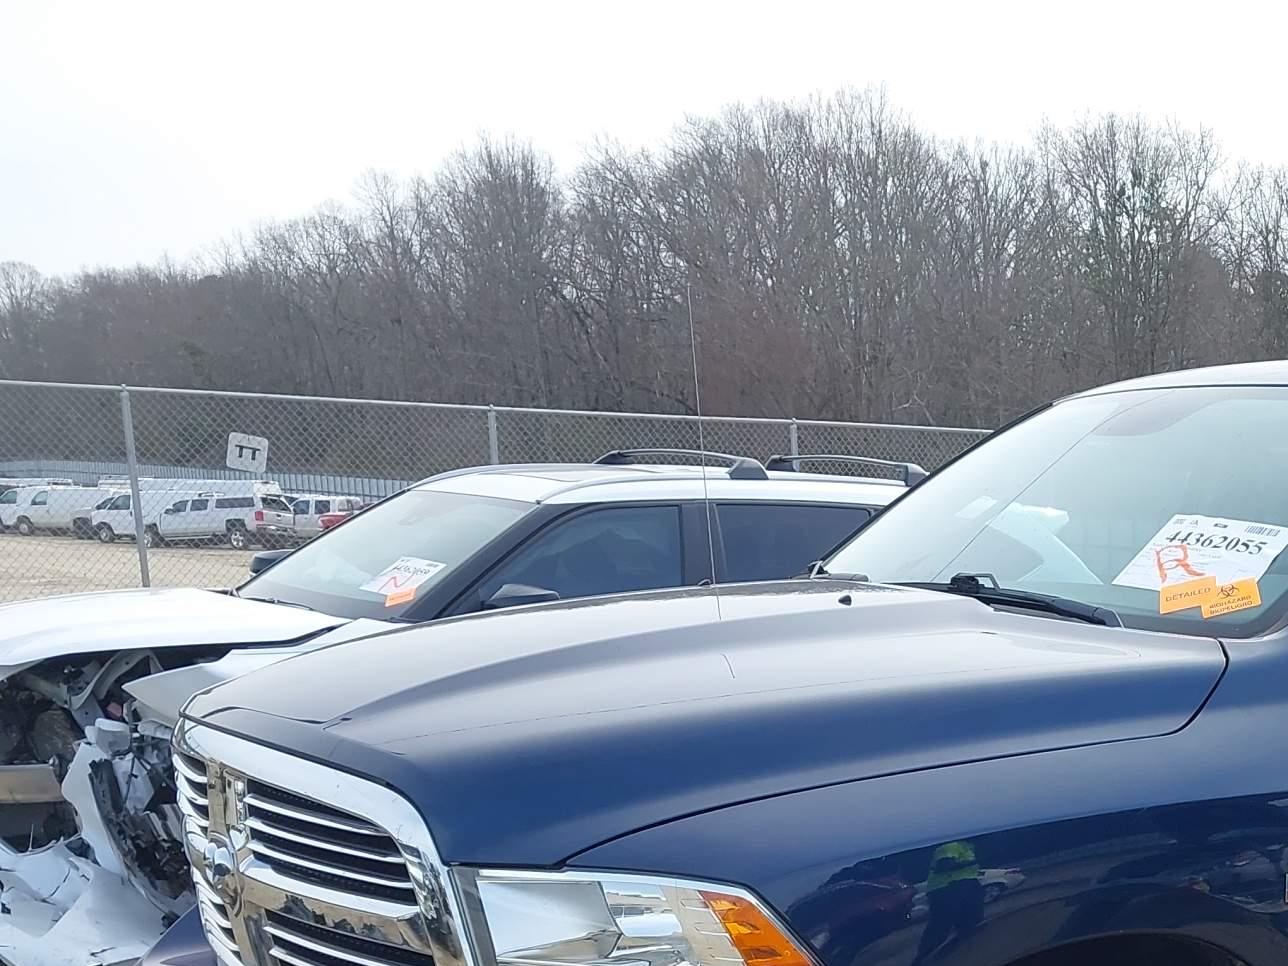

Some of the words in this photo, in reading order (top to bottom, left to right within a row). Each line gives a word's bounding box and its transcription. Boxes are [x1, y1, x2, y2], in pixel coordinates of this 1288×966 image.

[235, 444, 261, 461] TT
[1165, 529, 1268, 555] 44362055
[1154, 543, 1207, 584] R
[1165, 586, 1212, 603] DETAILED
[1209, 595, 1252, 609] BIOHAZARD
